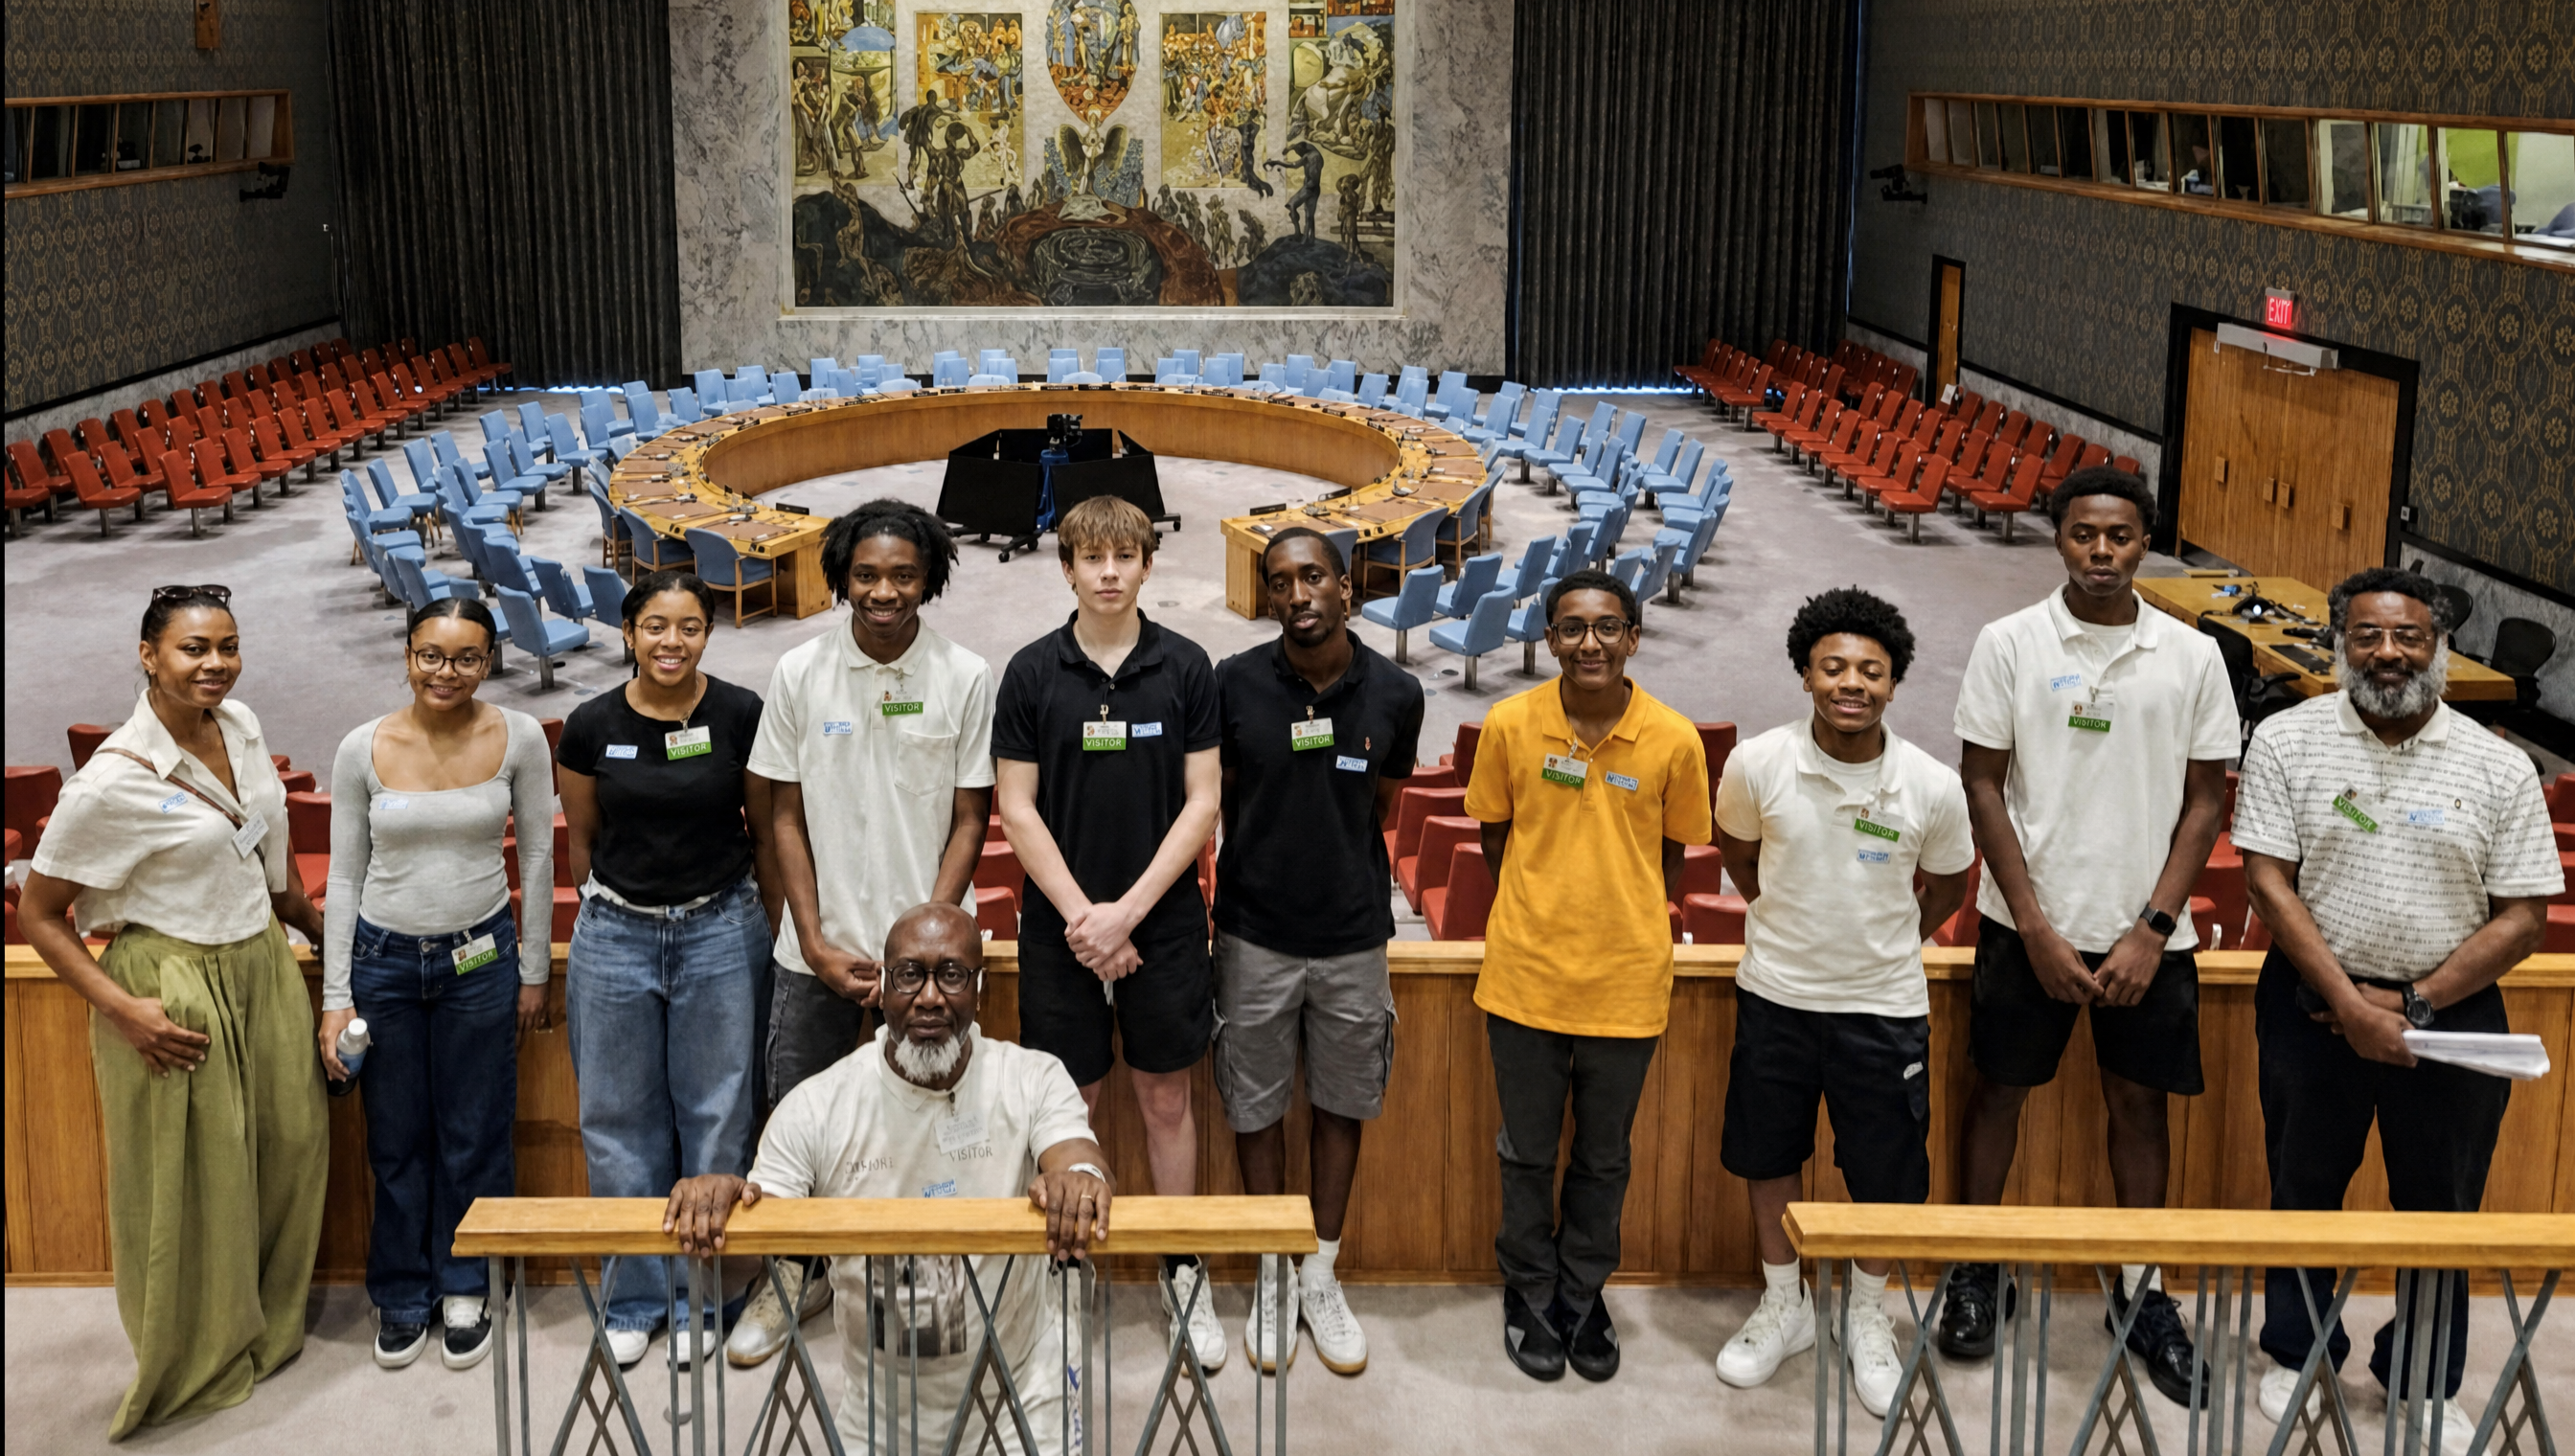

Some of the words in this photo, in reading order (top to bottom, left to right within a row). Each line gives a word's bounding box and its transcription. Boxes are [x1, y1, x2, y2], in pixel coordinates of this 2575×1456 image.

[2268, 298, 2290, 325] EXIT
[884, 703, 920, 713] VISITOR
[2073, 717, 2107, 729] VISITOR
[1085, 739, 1122, 747] VISITOR
[1295, 736, 1331, 747] VISITOR
[671, 743, 707, 757] VISITOR
[1546, 769, 1582, 785] VISITOR
[1859, 820, 1895, 838] VISITOR
[459, 951, 493, 971] VISITOR
[949, 1146, 992, 1162] VISITOR
